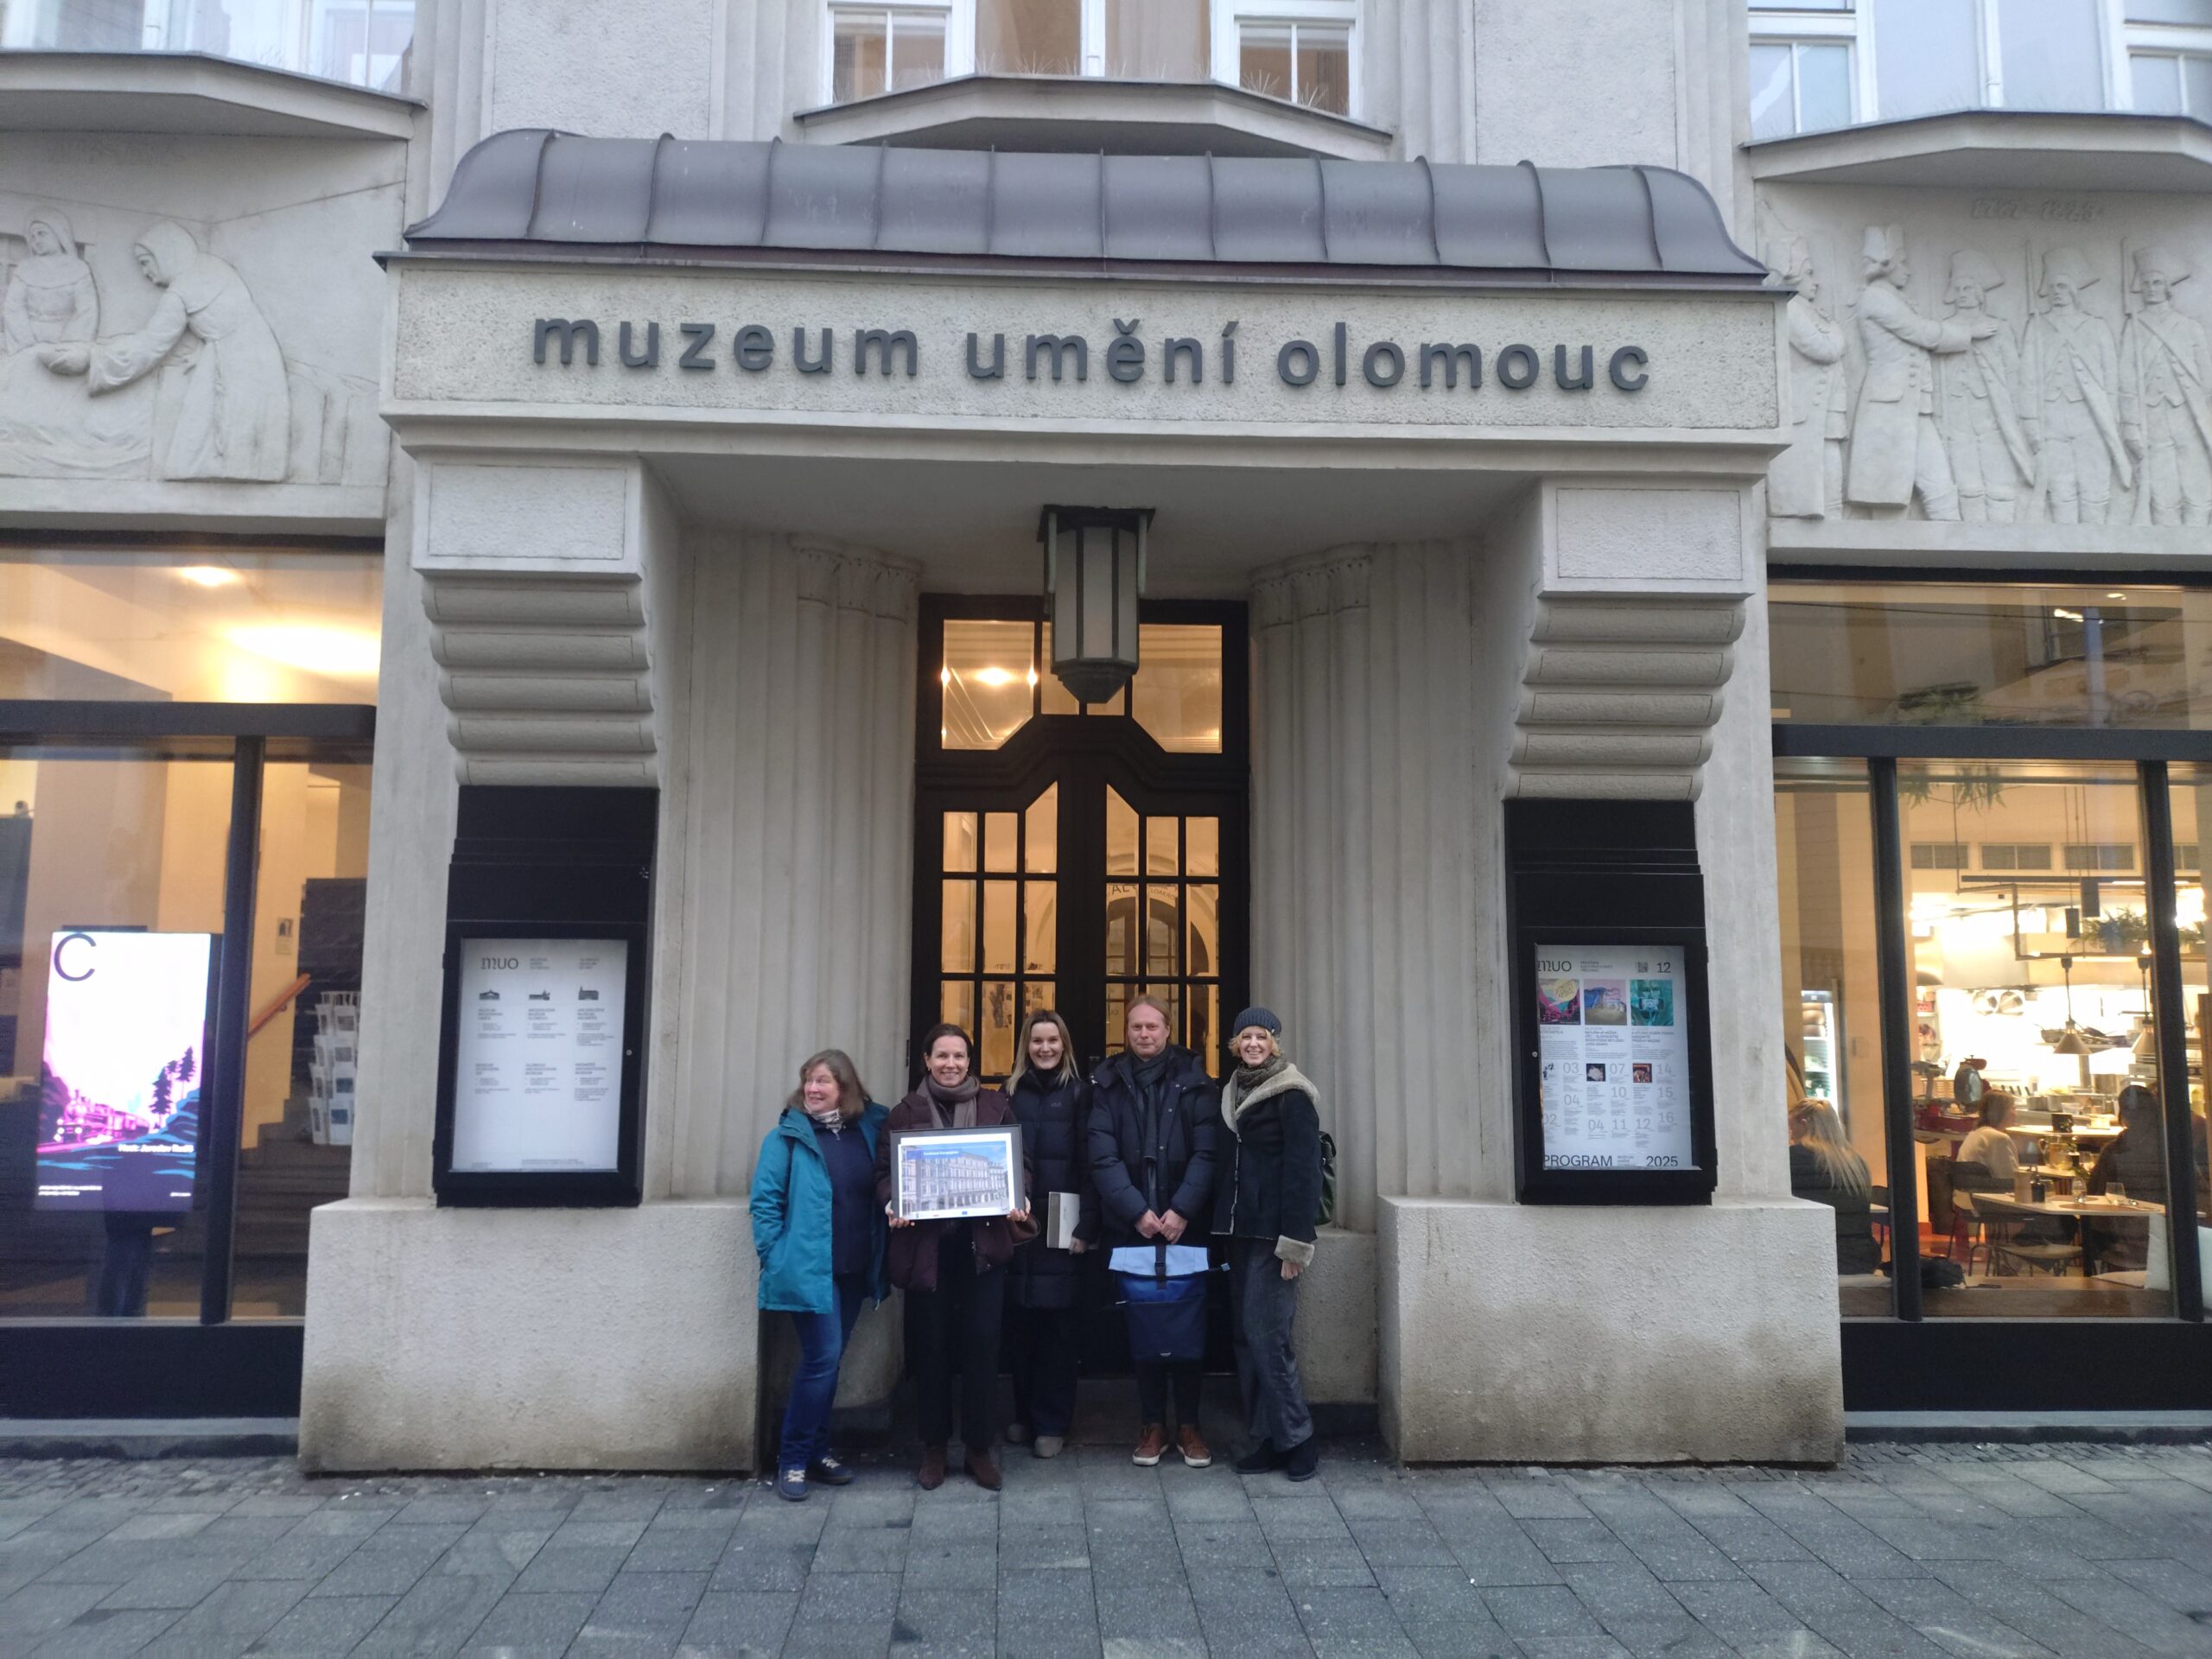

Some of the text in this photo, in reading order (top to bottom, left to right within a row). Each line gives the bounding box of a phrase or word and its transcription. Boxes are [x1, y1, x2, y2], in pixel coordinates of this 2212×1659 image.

[534, 319, 1648, 394] muzeum umění olomouc
[1656, 962, 1671, 973] 12
[1563, 1063, 1580, 1074] 03
[1610, 1063, 1624, 1074] 07
[1611, 1087, 1626, 1097] 10
[1564, 1094, 1580, 1106] 04
[1588, 1119, 1604, 1131] 04
[1612, 1119, 1626, 1130] 11
[1636, 1118, 1650, 1129] 12
[1543, 1154, 1612, 1166] PROGRAM
[1646, 1155, 1679, 1167] 2025
